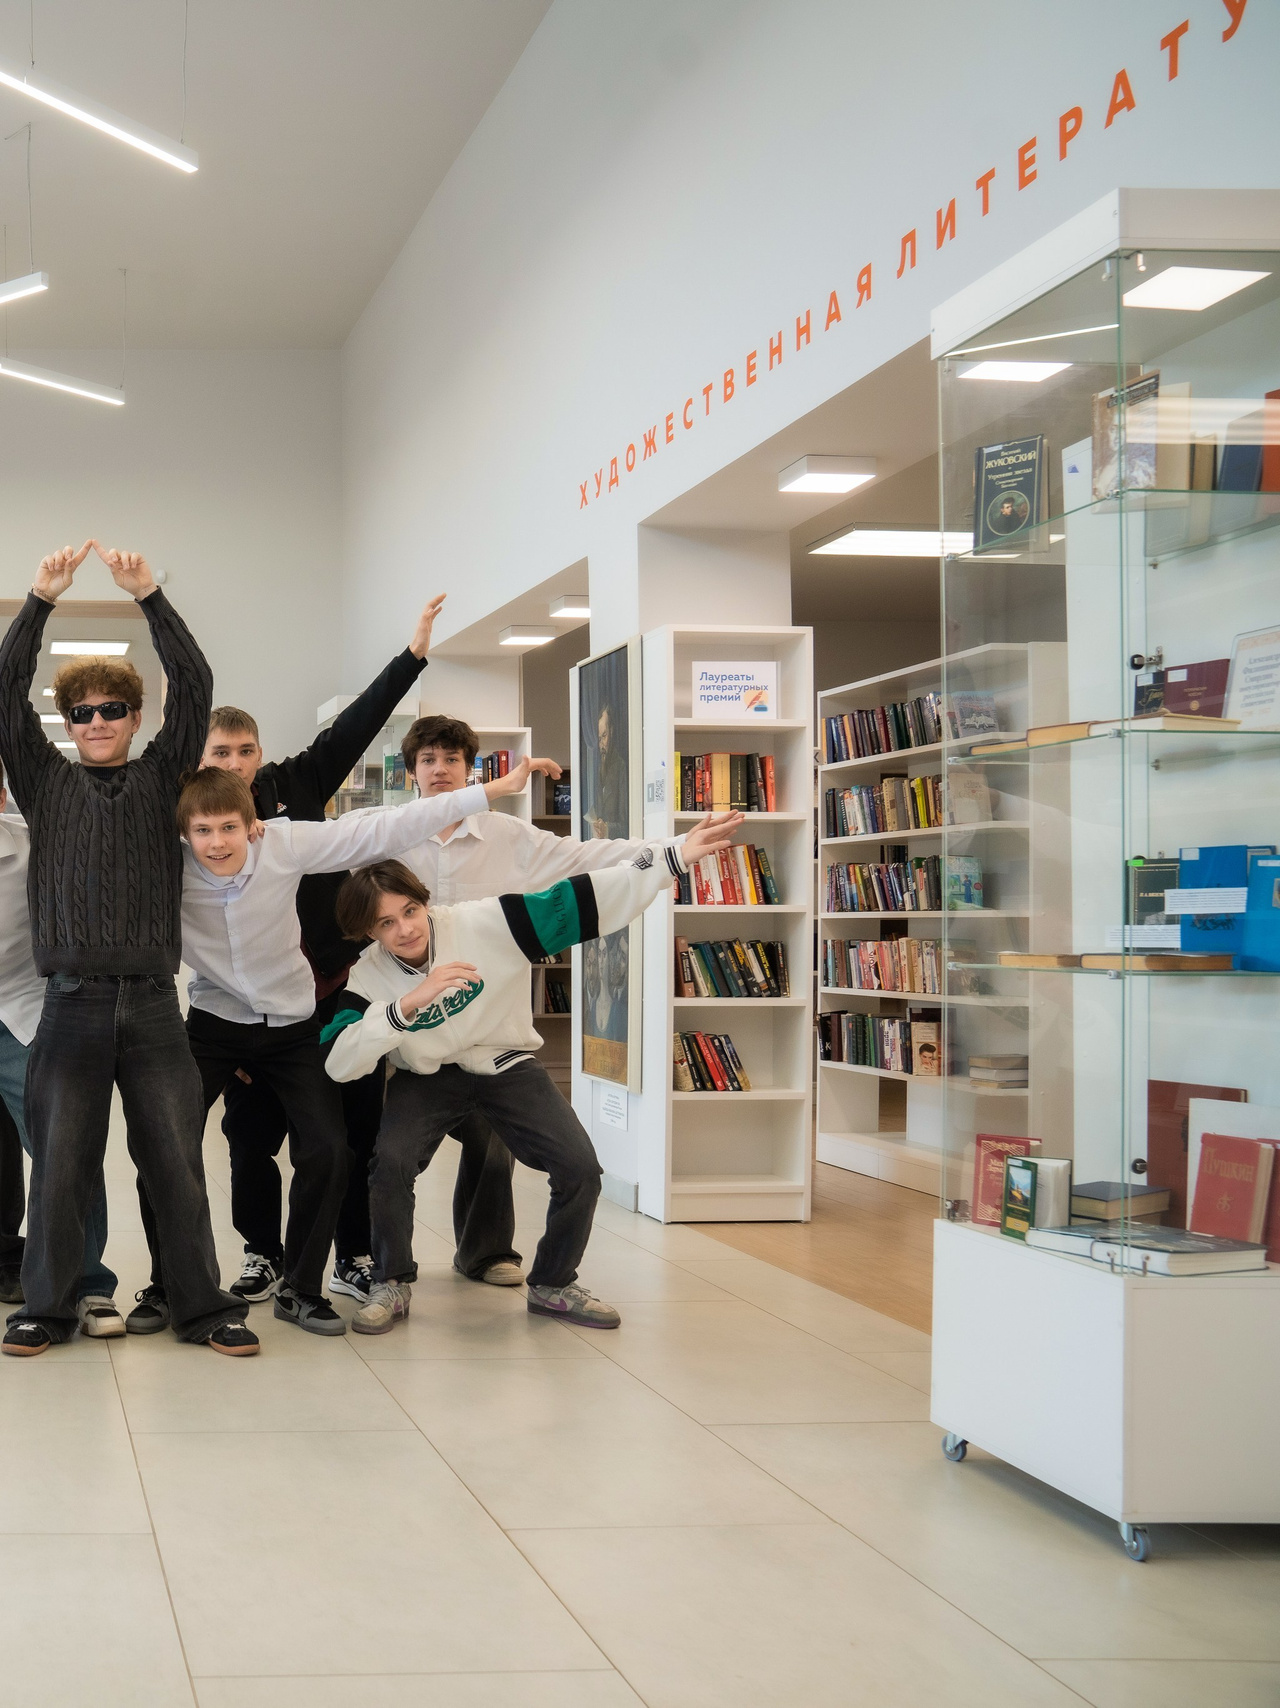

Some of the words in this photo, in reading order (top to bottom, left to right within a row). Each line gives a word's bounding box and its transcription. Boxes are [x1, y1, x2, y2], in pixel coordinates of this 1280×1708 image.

[578, 262, 873, 510] ХУДОЖЕСТВЕННАЯ
[985, 450, 1036, 469] ЖУКОВСКИЙ
[700, 672, 754, 683] Лауреаты
[700, 692, 741, 703] премий
[1202, 1146, 1255, 1182] Пушкин
